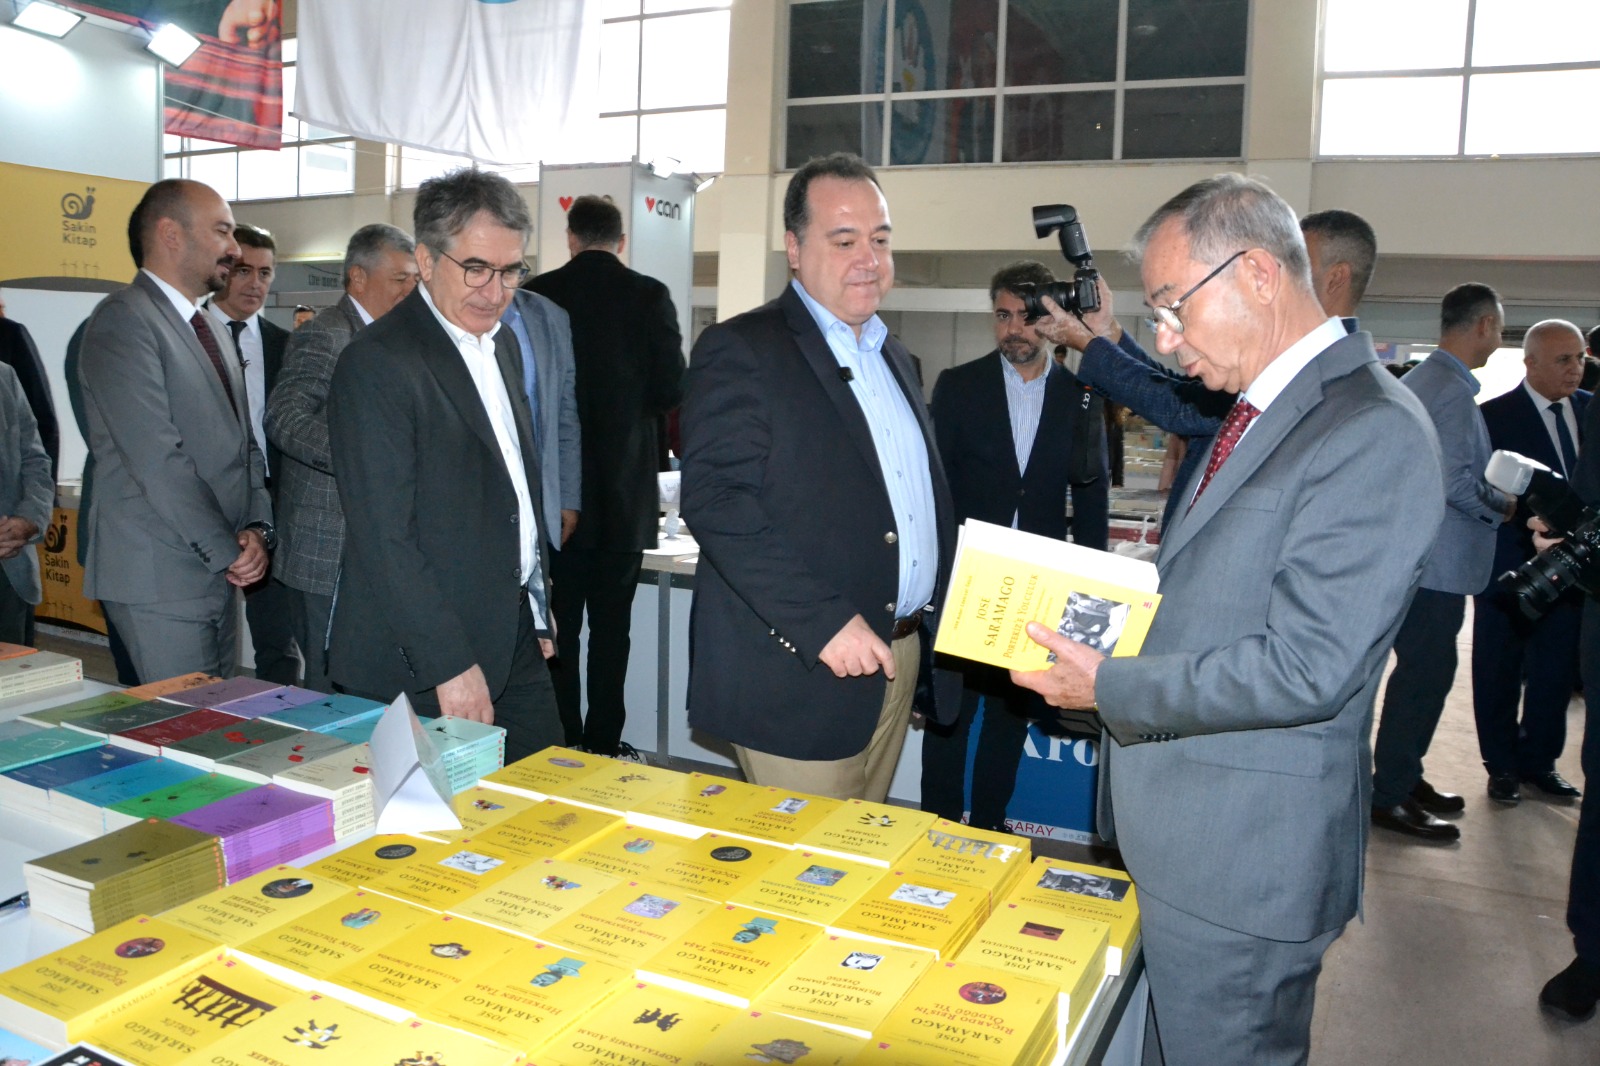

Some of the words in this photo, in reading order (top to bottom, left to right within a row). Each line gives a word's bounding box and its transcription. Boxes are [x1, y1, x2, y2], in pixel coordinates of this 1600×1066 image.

[656, 199, 681, 220] can
[62, 220, 96, 233] Sakin
[62, 233, 97, 248] Kitap
[45, 554, 69, 569] Sakin
[45, 568, 70, 587] Kitap
[984, 575, 1015, 648] SARAMAGO
[1004, 819, 1054, 837] SARAY
[822, 831, 889, 847] SARAMAGO
[321, 865, 373, 881] ARAMAGO
[917, 857, 986, 874] SARAMAGO
[398, 873, 460, 894] SARAMAGO
[664, 867, 732, 886] SARAMAGO
[484, 896, 551, 919] SARAMAGO
[759, 887, 832, 908] SARAMAGO
[196, 904, 258, 929] SARAMAGO
[860, 911, 937, 931] SARAMAGO
[573, 922, 648, 948] SARAMAGO
[278, 934, 345, 960] SARAMAGO
[683, 940, 707, 952] TAŞA
[676, 950, 757, 975] SARAMAGO
[710, 947, 771, 968] HEYKELDEN
[981, 948, 1064, 972] SARAMAGO
[36, 966, 104, 995] SARAMAGO
[368, 963, 441, 990] SARAMAGO
[475, 983, 500, 997] TAŞA
[788, 984, 873, 1007] SARAMAGO
[463, 994, 544, 1024] SARAMAGO
[499, 991, 563, 1017] HEYKELDEN
[933, 1002, 952, 1014] YIL
[577, 1028, 609, 1041] ADAM
[910, 1017, 1003, 1045] SARAMAGO
[960, 1016, 1015, 1036] RICARDO
[124, 1021, 197, 1054] SARAMAGO
[935, 1032, 967, 1045] JOSÉ
[609, 1036, 683, 1064] KOPYALANMIŞ
